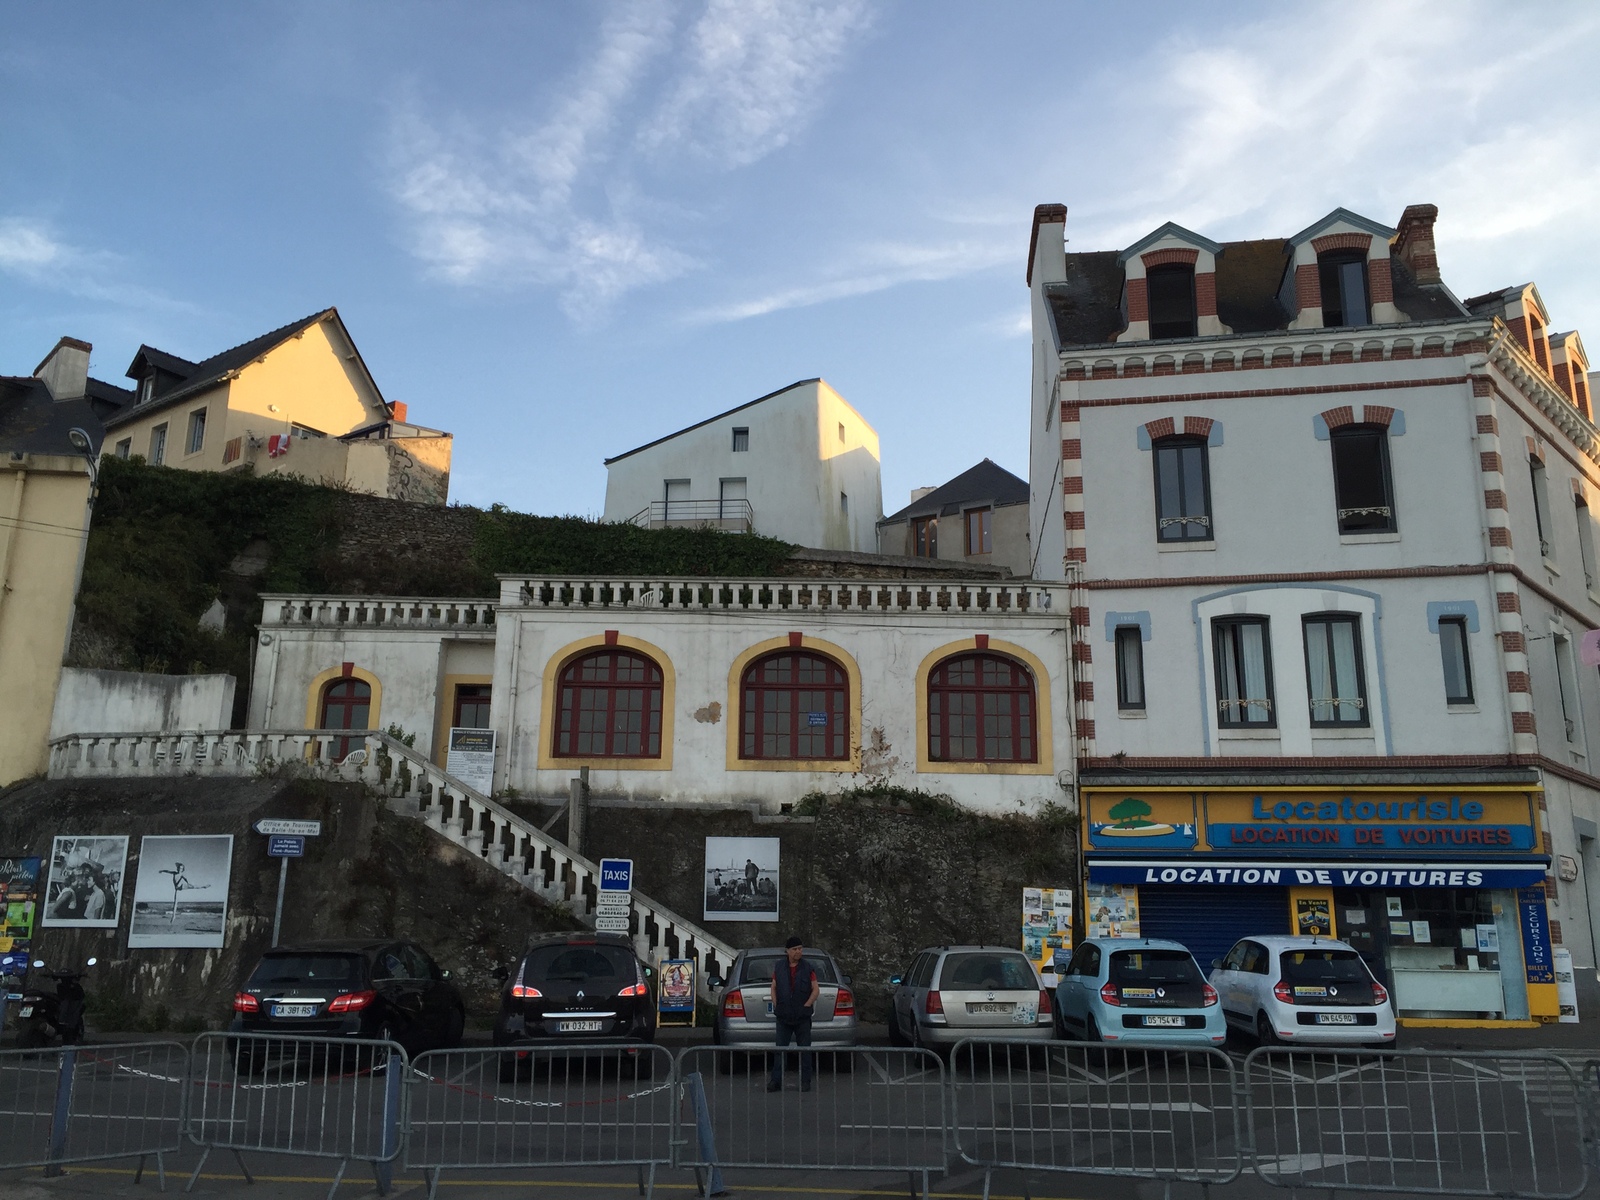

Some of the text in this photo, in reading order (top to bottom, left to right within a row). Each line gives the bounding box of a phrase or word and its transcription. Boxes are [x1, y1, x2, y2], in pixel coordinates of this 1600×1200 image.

[1252, 796, 1485, 821] Locatourisle
[1231, 827, 1513, 846] LOCATION DE VOITURES
[603, 870, 628, 880] TAXIS
[1145, 868, 1484, 887] LOCATION DE VOITURES
[1528, 905, 1544, 963] EXCURSIONS
